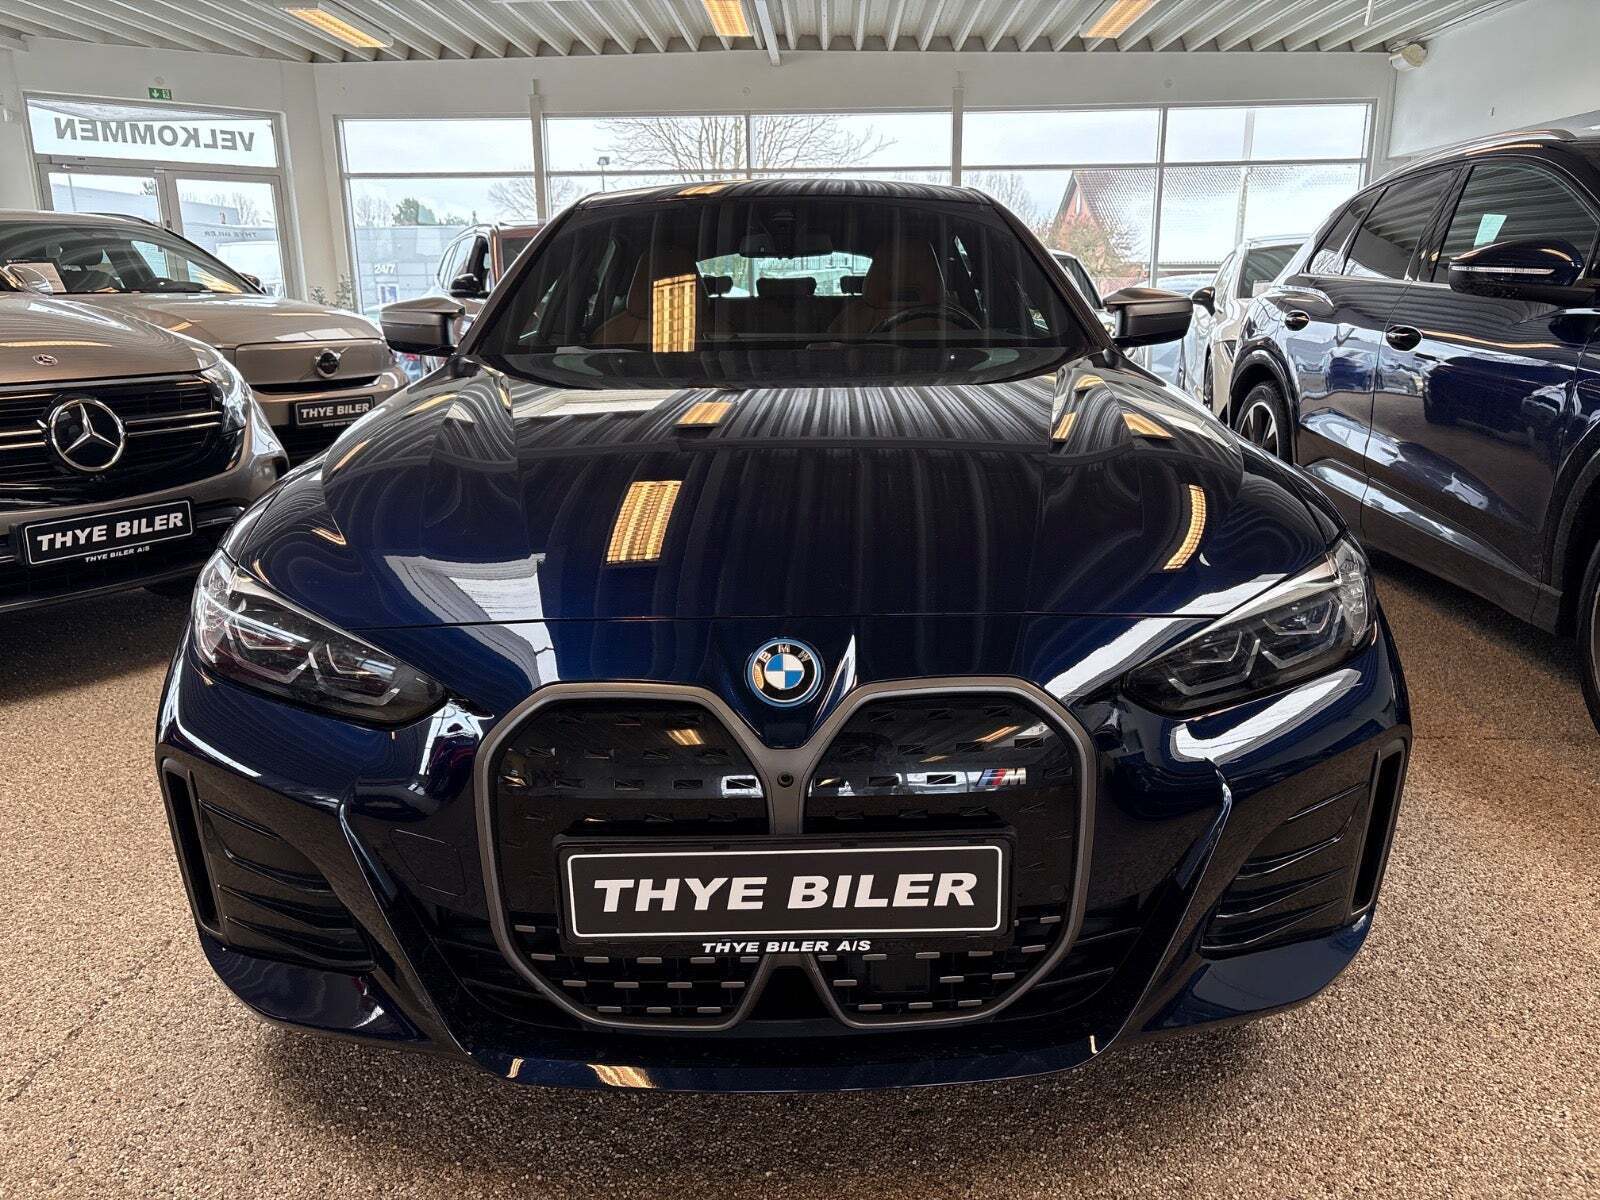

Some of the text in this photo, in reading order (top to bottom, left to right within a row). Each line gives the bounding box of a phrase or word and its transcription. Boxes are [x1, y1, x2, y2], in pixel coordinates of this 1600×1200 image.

[301, 403, 370, 418] THYE BILER
[37, 512, 184, 551] THYE BILER
[85, 553, 107, 562] THYE
[110, 548, 134, 557] BILER
[759, 643, 811, 663] BMW
[594, 872, 978, 912] THYE BILER
[702, 942, 759, 953] THYE
[765, 941, 829, 953] BILER
